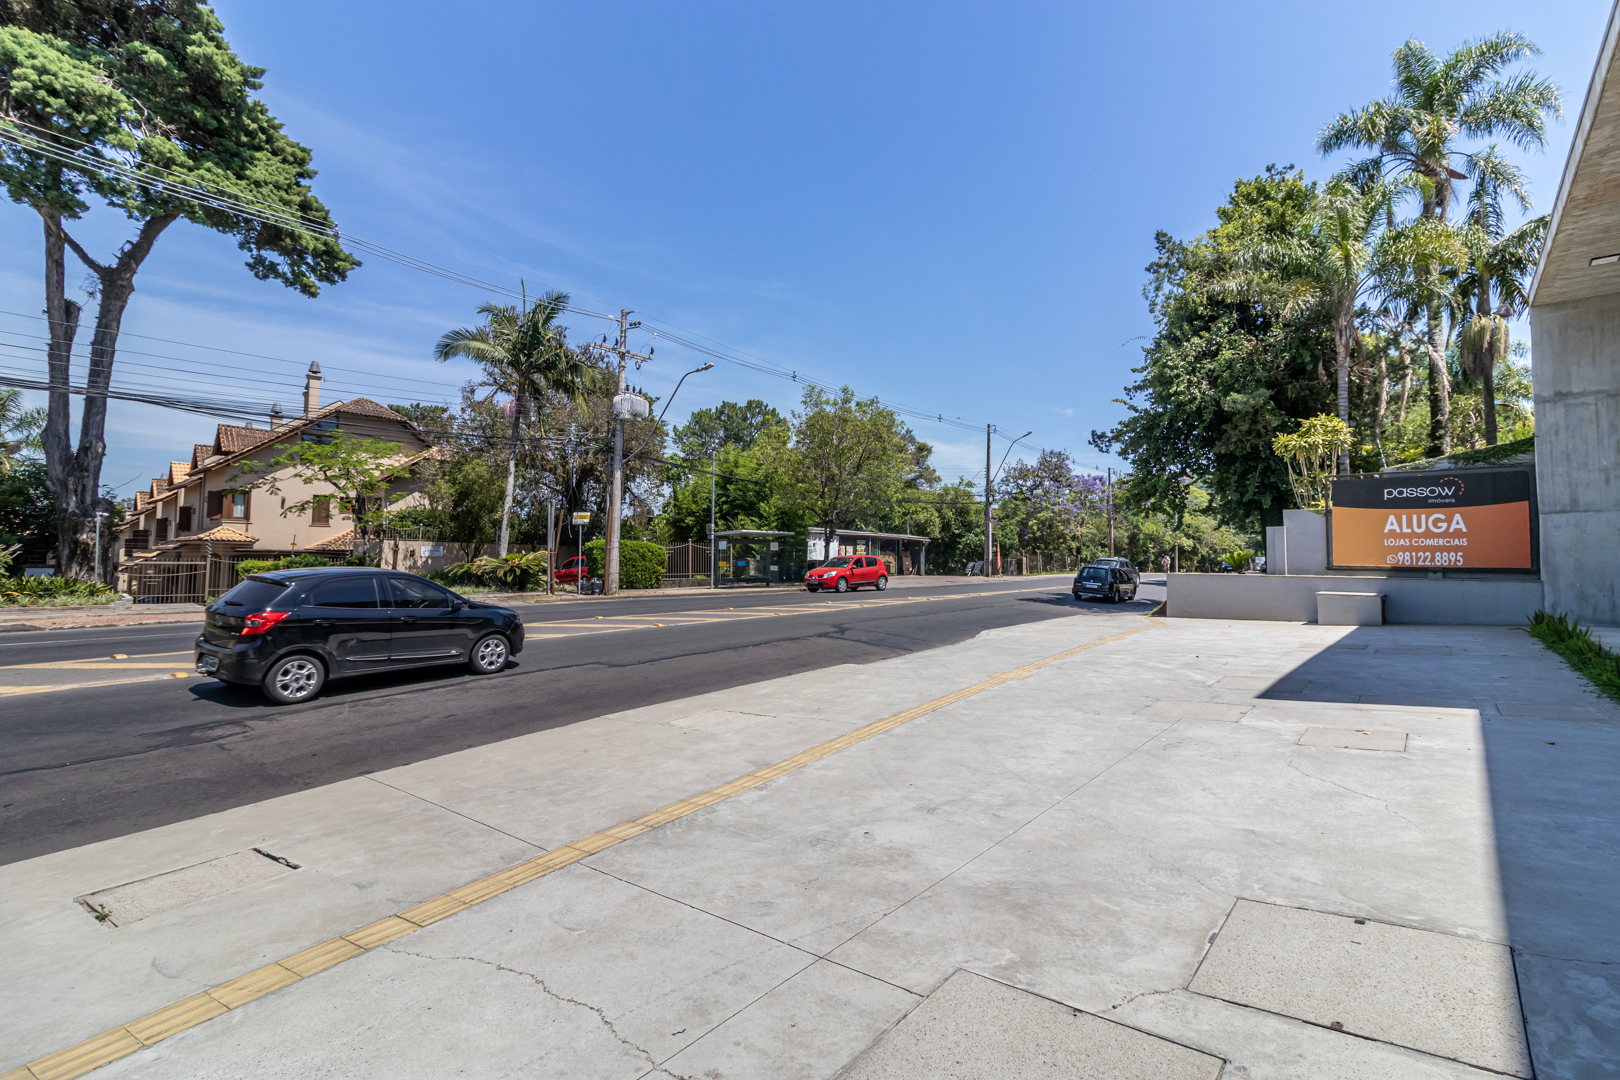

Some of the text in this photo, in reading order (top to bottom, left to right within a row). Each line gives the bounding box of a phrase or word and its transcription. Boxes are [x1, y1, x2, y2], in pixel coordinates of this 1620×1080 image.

[1384, 486, 1455, 500] passow
[1384, 513, 1467, 533] ALUGA
[1384, 538, 1468, 546] LOJAS COMERCIAIS
[1398, 552, 1463, 566] 98122.8895
